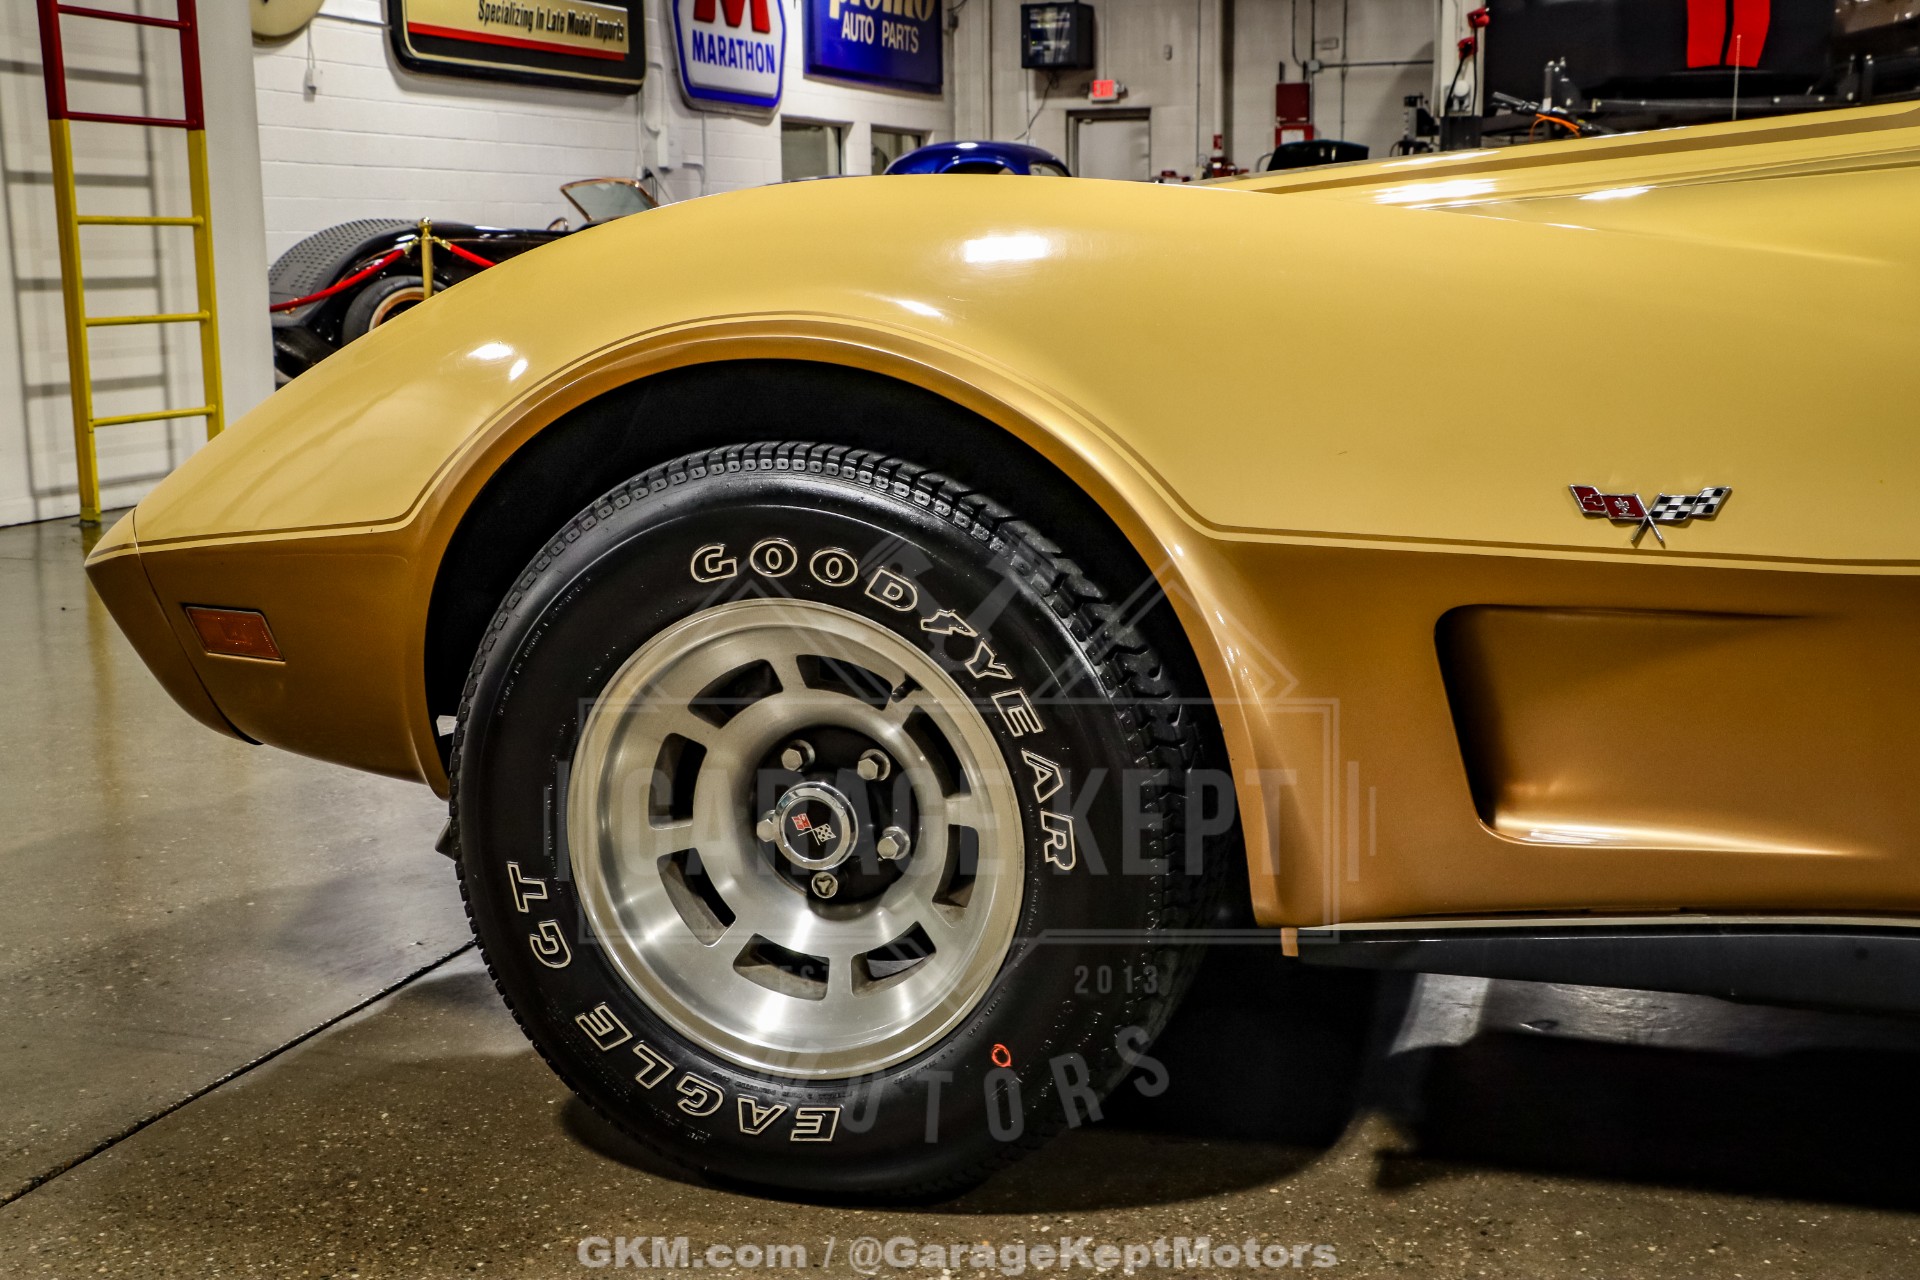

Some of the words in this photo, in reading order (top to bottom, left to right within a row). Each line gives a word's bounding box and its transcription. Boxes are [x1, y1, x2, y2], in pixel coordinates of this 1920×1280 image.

[478, 0, 534, 33] Specializing
[536, 6, 544, 31] In
[546, 8, 565, 33] Late
[566, 9, 592, 37] Model
[594, 13, 625, 43] Imports
[692, 29, 776, 74] MARATHON
[841, 10, 875, 45] AUTO
[882, 20, 919, 54] PARTS
[690, 537, 1077, 871] GOODYEAR
[506, 860, 573, 969] GT
[575, 1001, 843, 1142] EAGLE
